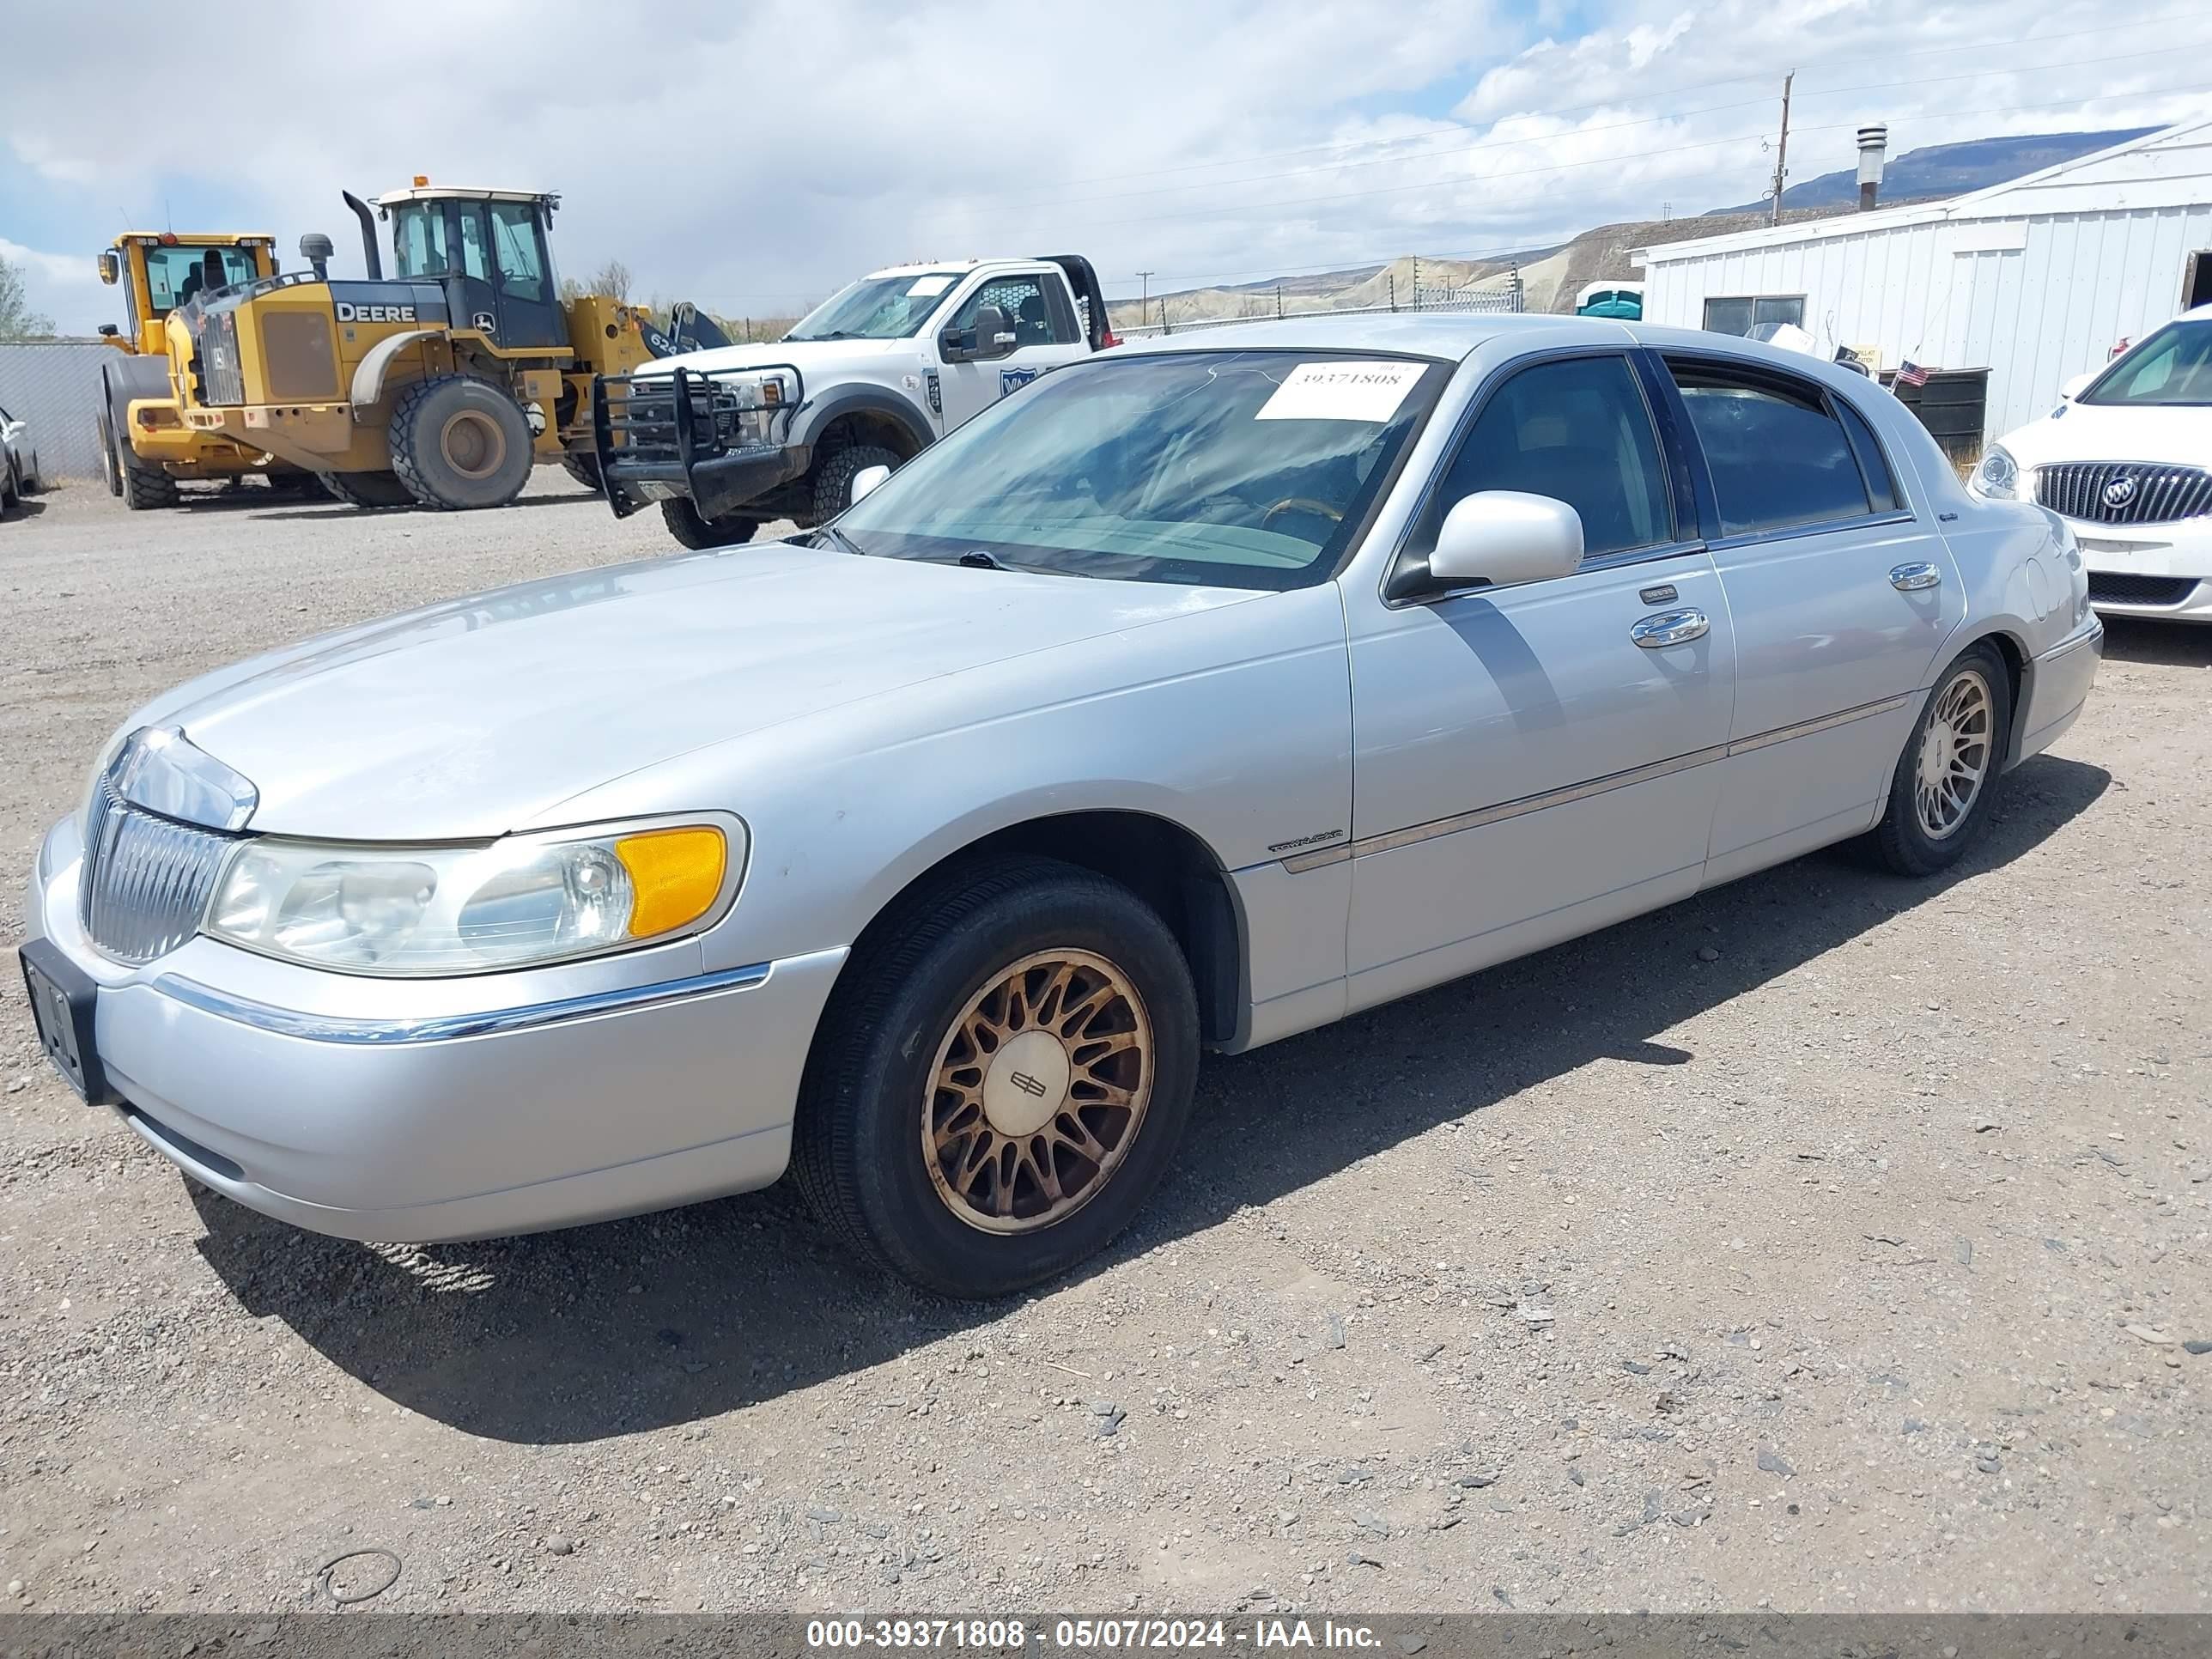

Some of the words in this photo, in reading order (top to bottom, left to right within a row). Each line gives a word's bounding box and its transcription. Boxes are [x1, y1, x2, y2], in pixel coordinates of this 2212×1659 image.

[337, 302, 416, 322] DEERE
[1295, 374, 1401, 385] 39371808
[1268, 838, 1311, 852] TOWN
[1311, 830, 1344, 843] CAR
